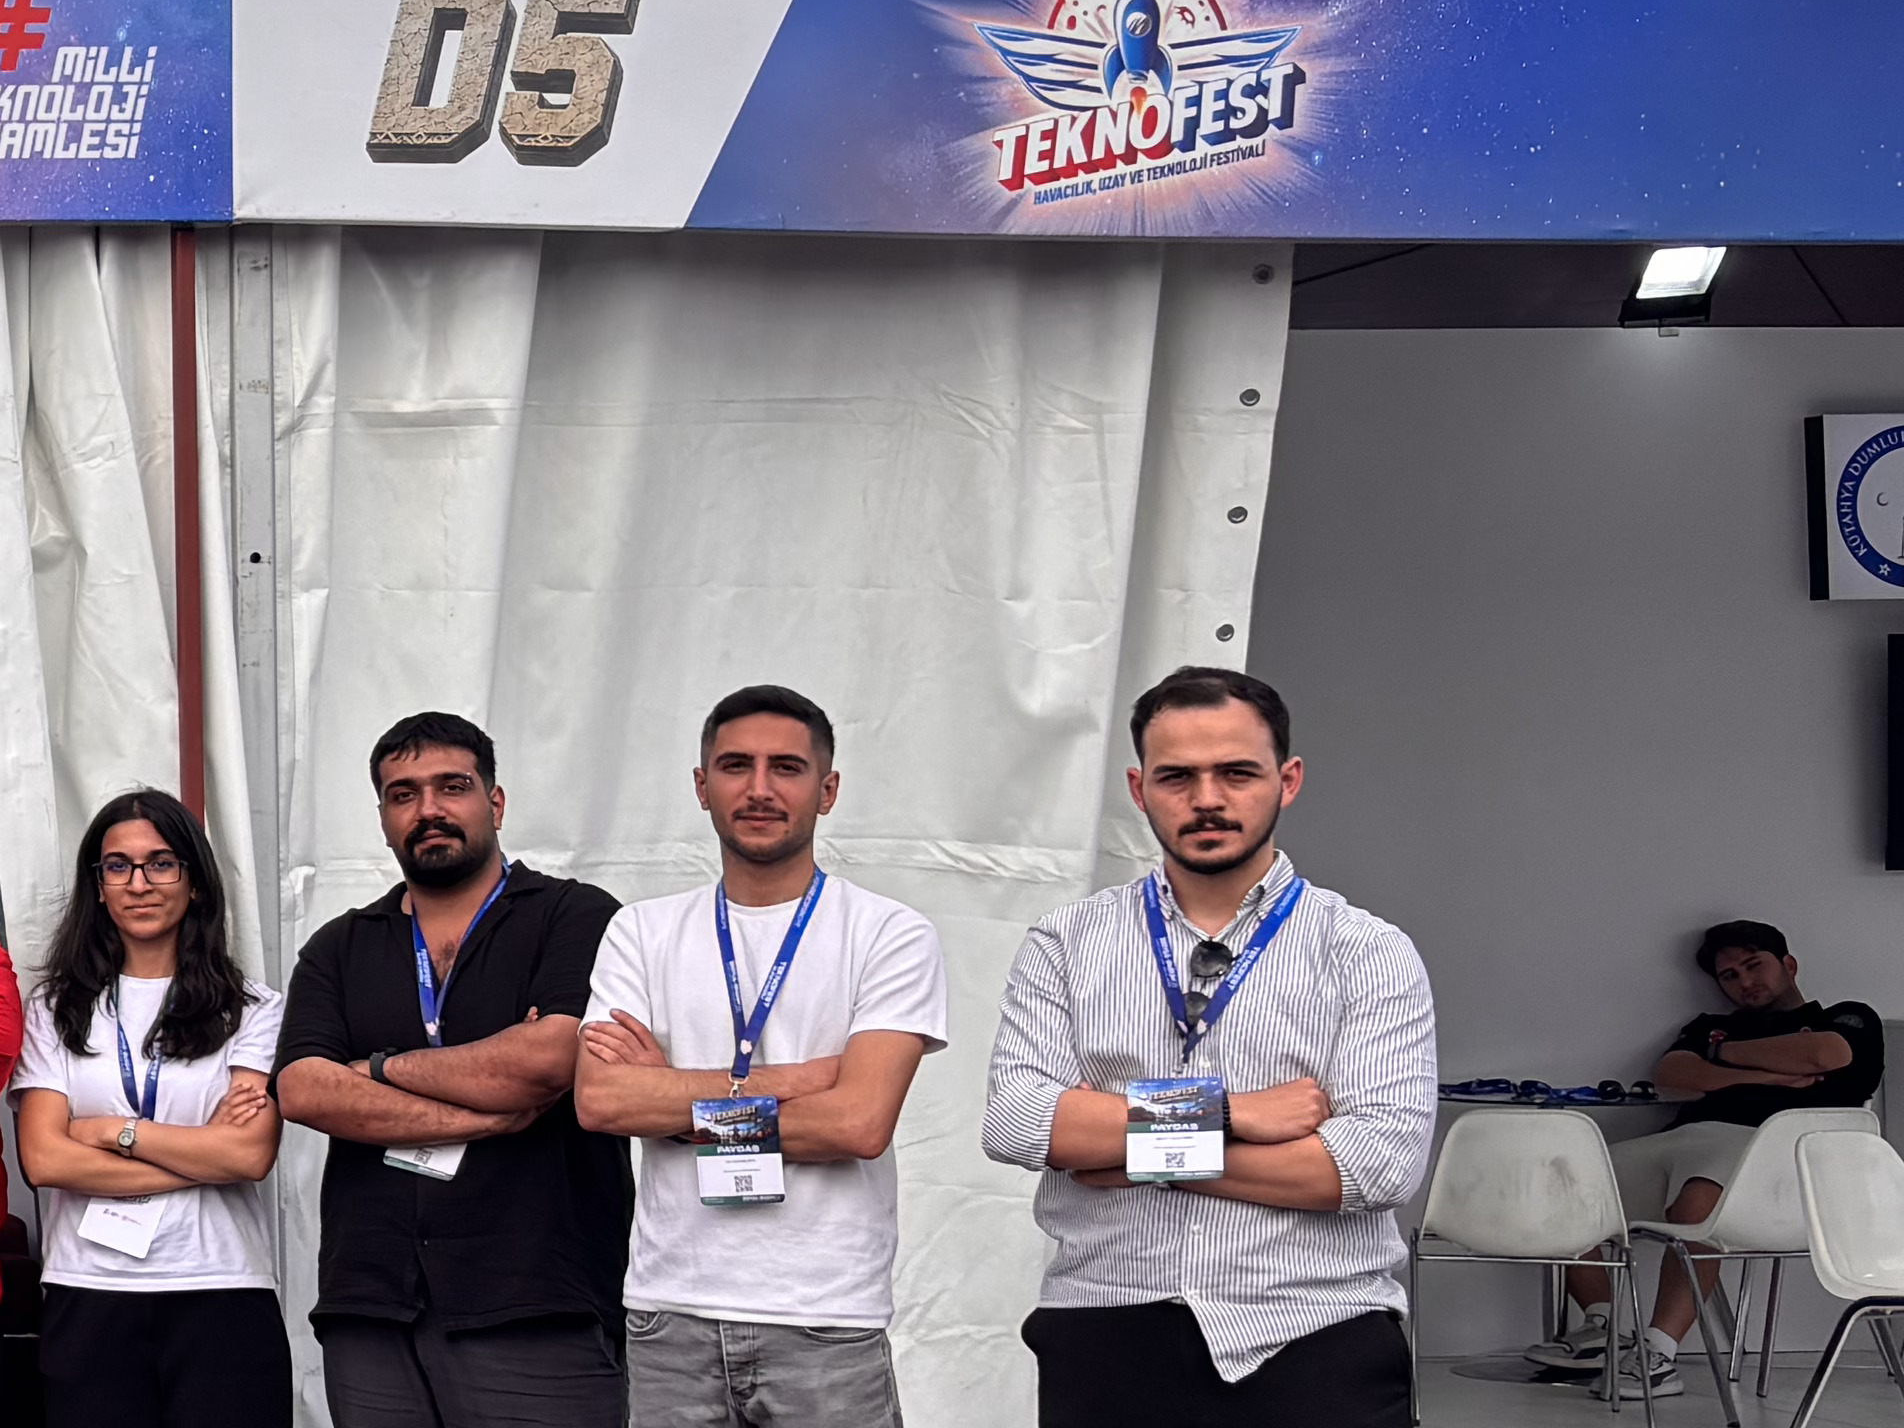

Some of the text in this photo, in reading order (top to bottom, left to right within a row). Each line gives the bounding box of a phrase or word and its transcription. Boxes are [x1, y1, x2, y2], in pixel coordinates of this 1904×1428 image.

[992, 62, 1306, 192] TEKNOFEST
[1098, 173, 1128, 191] UZAY
[1129, 170, 1145, 184] VE
